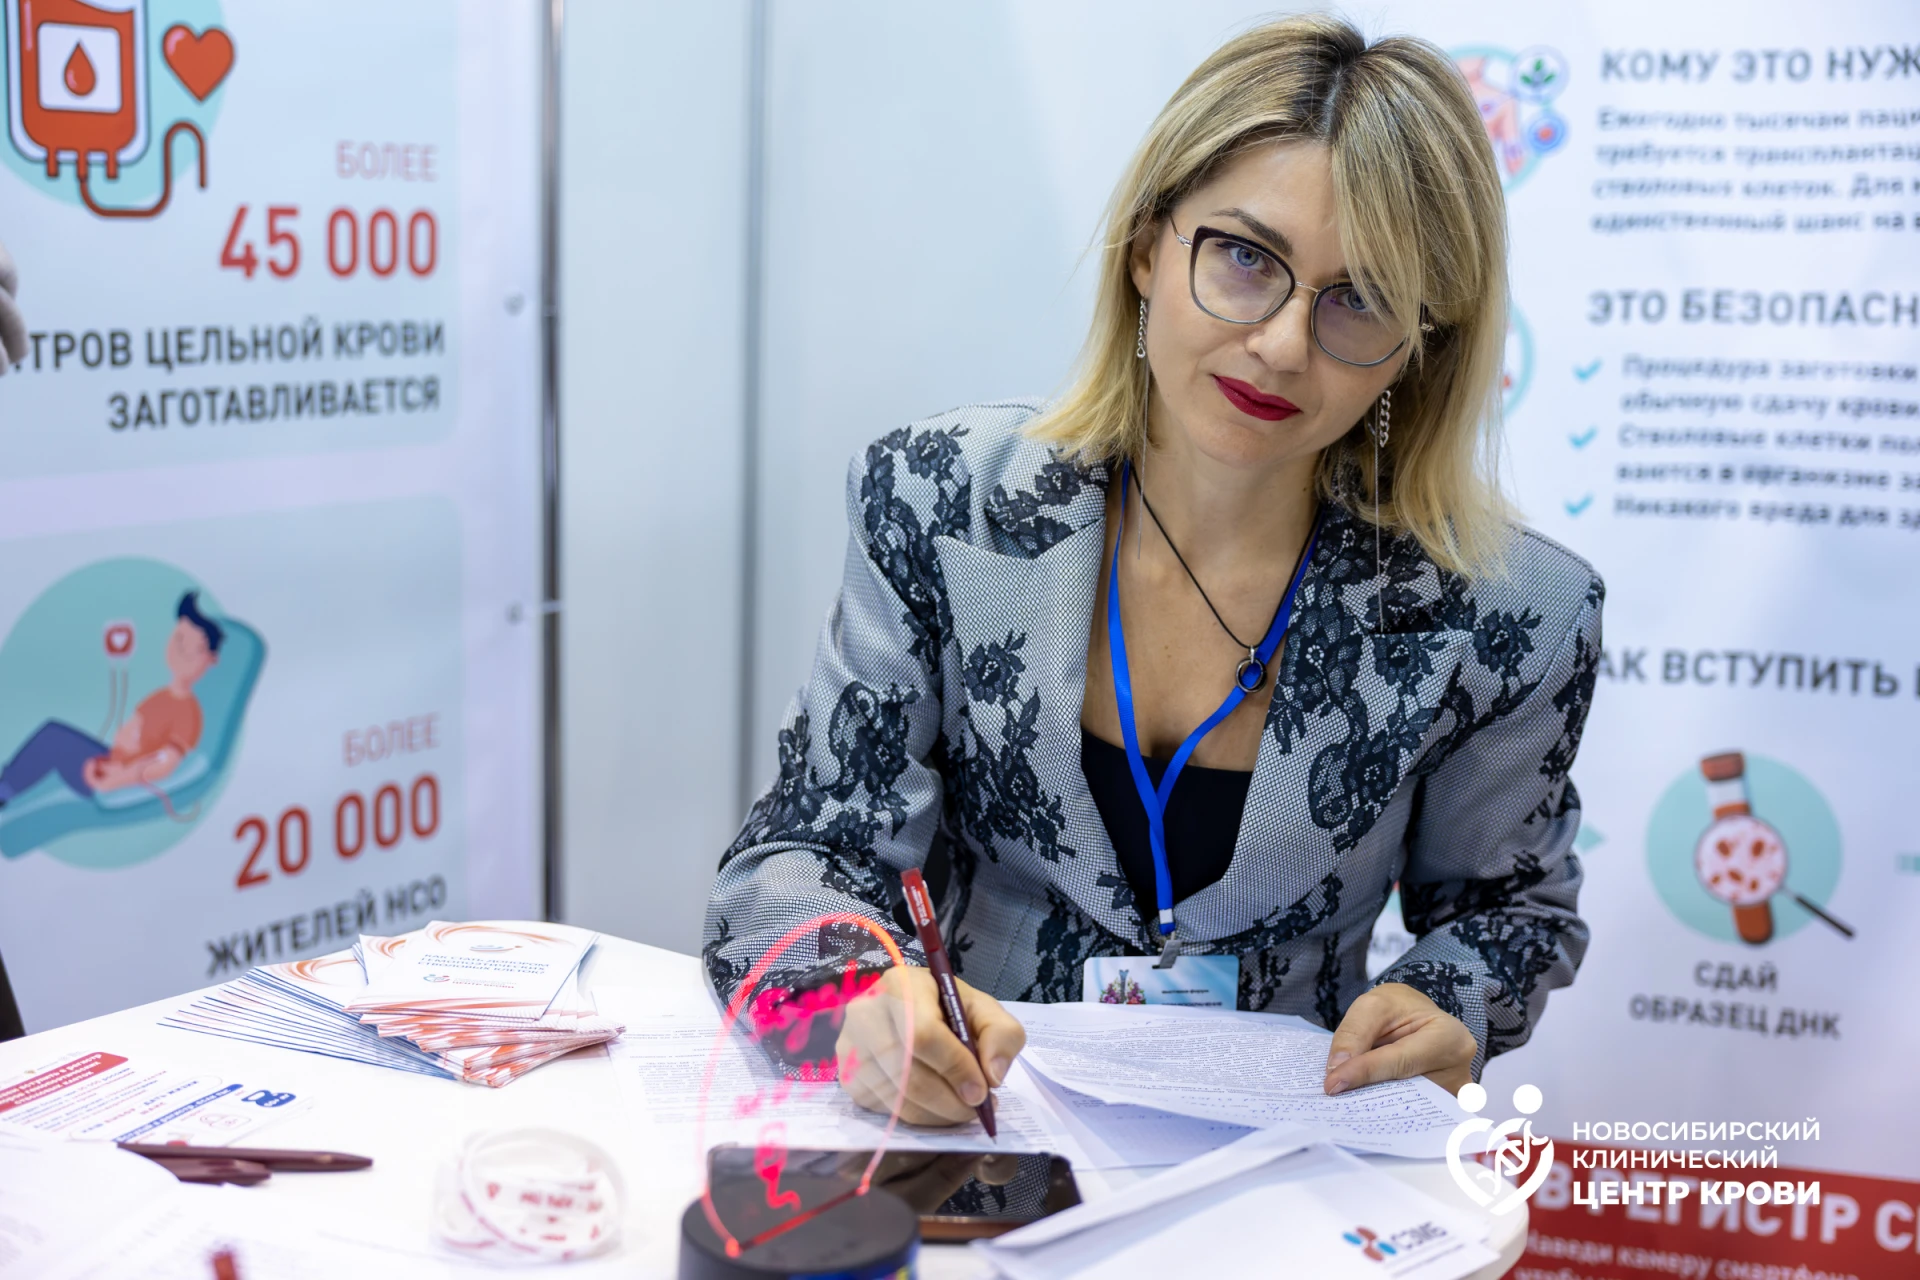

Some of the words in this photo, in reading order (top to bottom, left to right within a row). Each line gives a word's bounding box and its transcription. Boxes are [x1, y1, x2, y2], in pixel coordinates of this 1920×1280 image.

[1601, 49, 1720, 83] КОМУ
[1732, 48, 1812, 83] ЭТО
[336, 141, 438, 182] БОЛЕЕ
[220, 205, 302, 279] 45
[327, 207, 438, 279] 000
[1588, 290, 1667, 325] ЭТО
[1681, 289, 1920, 327] БЕЗОПАСН
[14, 330, 132, 371] ТРОВ
[146, 316, 323, 372] ЦЕЛЬНОЙ
[334, 320, 446, 359] КРОВИ
[108, 376, 440, 431] ЗАГОТАВЛИВАЕТСЯ
[1662, 648, 1900, 698] ВСТУПИТЬ
[342, 712, 440, 767] БОЛЕЕ
[234, 806, 311, 890] 20
[334, 771, 441, 860] 000
[206, 888, 377, 978] ЖИТЕЛЕЙ
[385, 874, 447, 925] НСО
[1694, 960, 1778, 993] СДАЙ
[1629, 994, 1769, 1036] ОБРАЗЕЦ
[1775, 1008, 1842, 1040] ДНК
[1874, 1198, 1920, 1254] С
